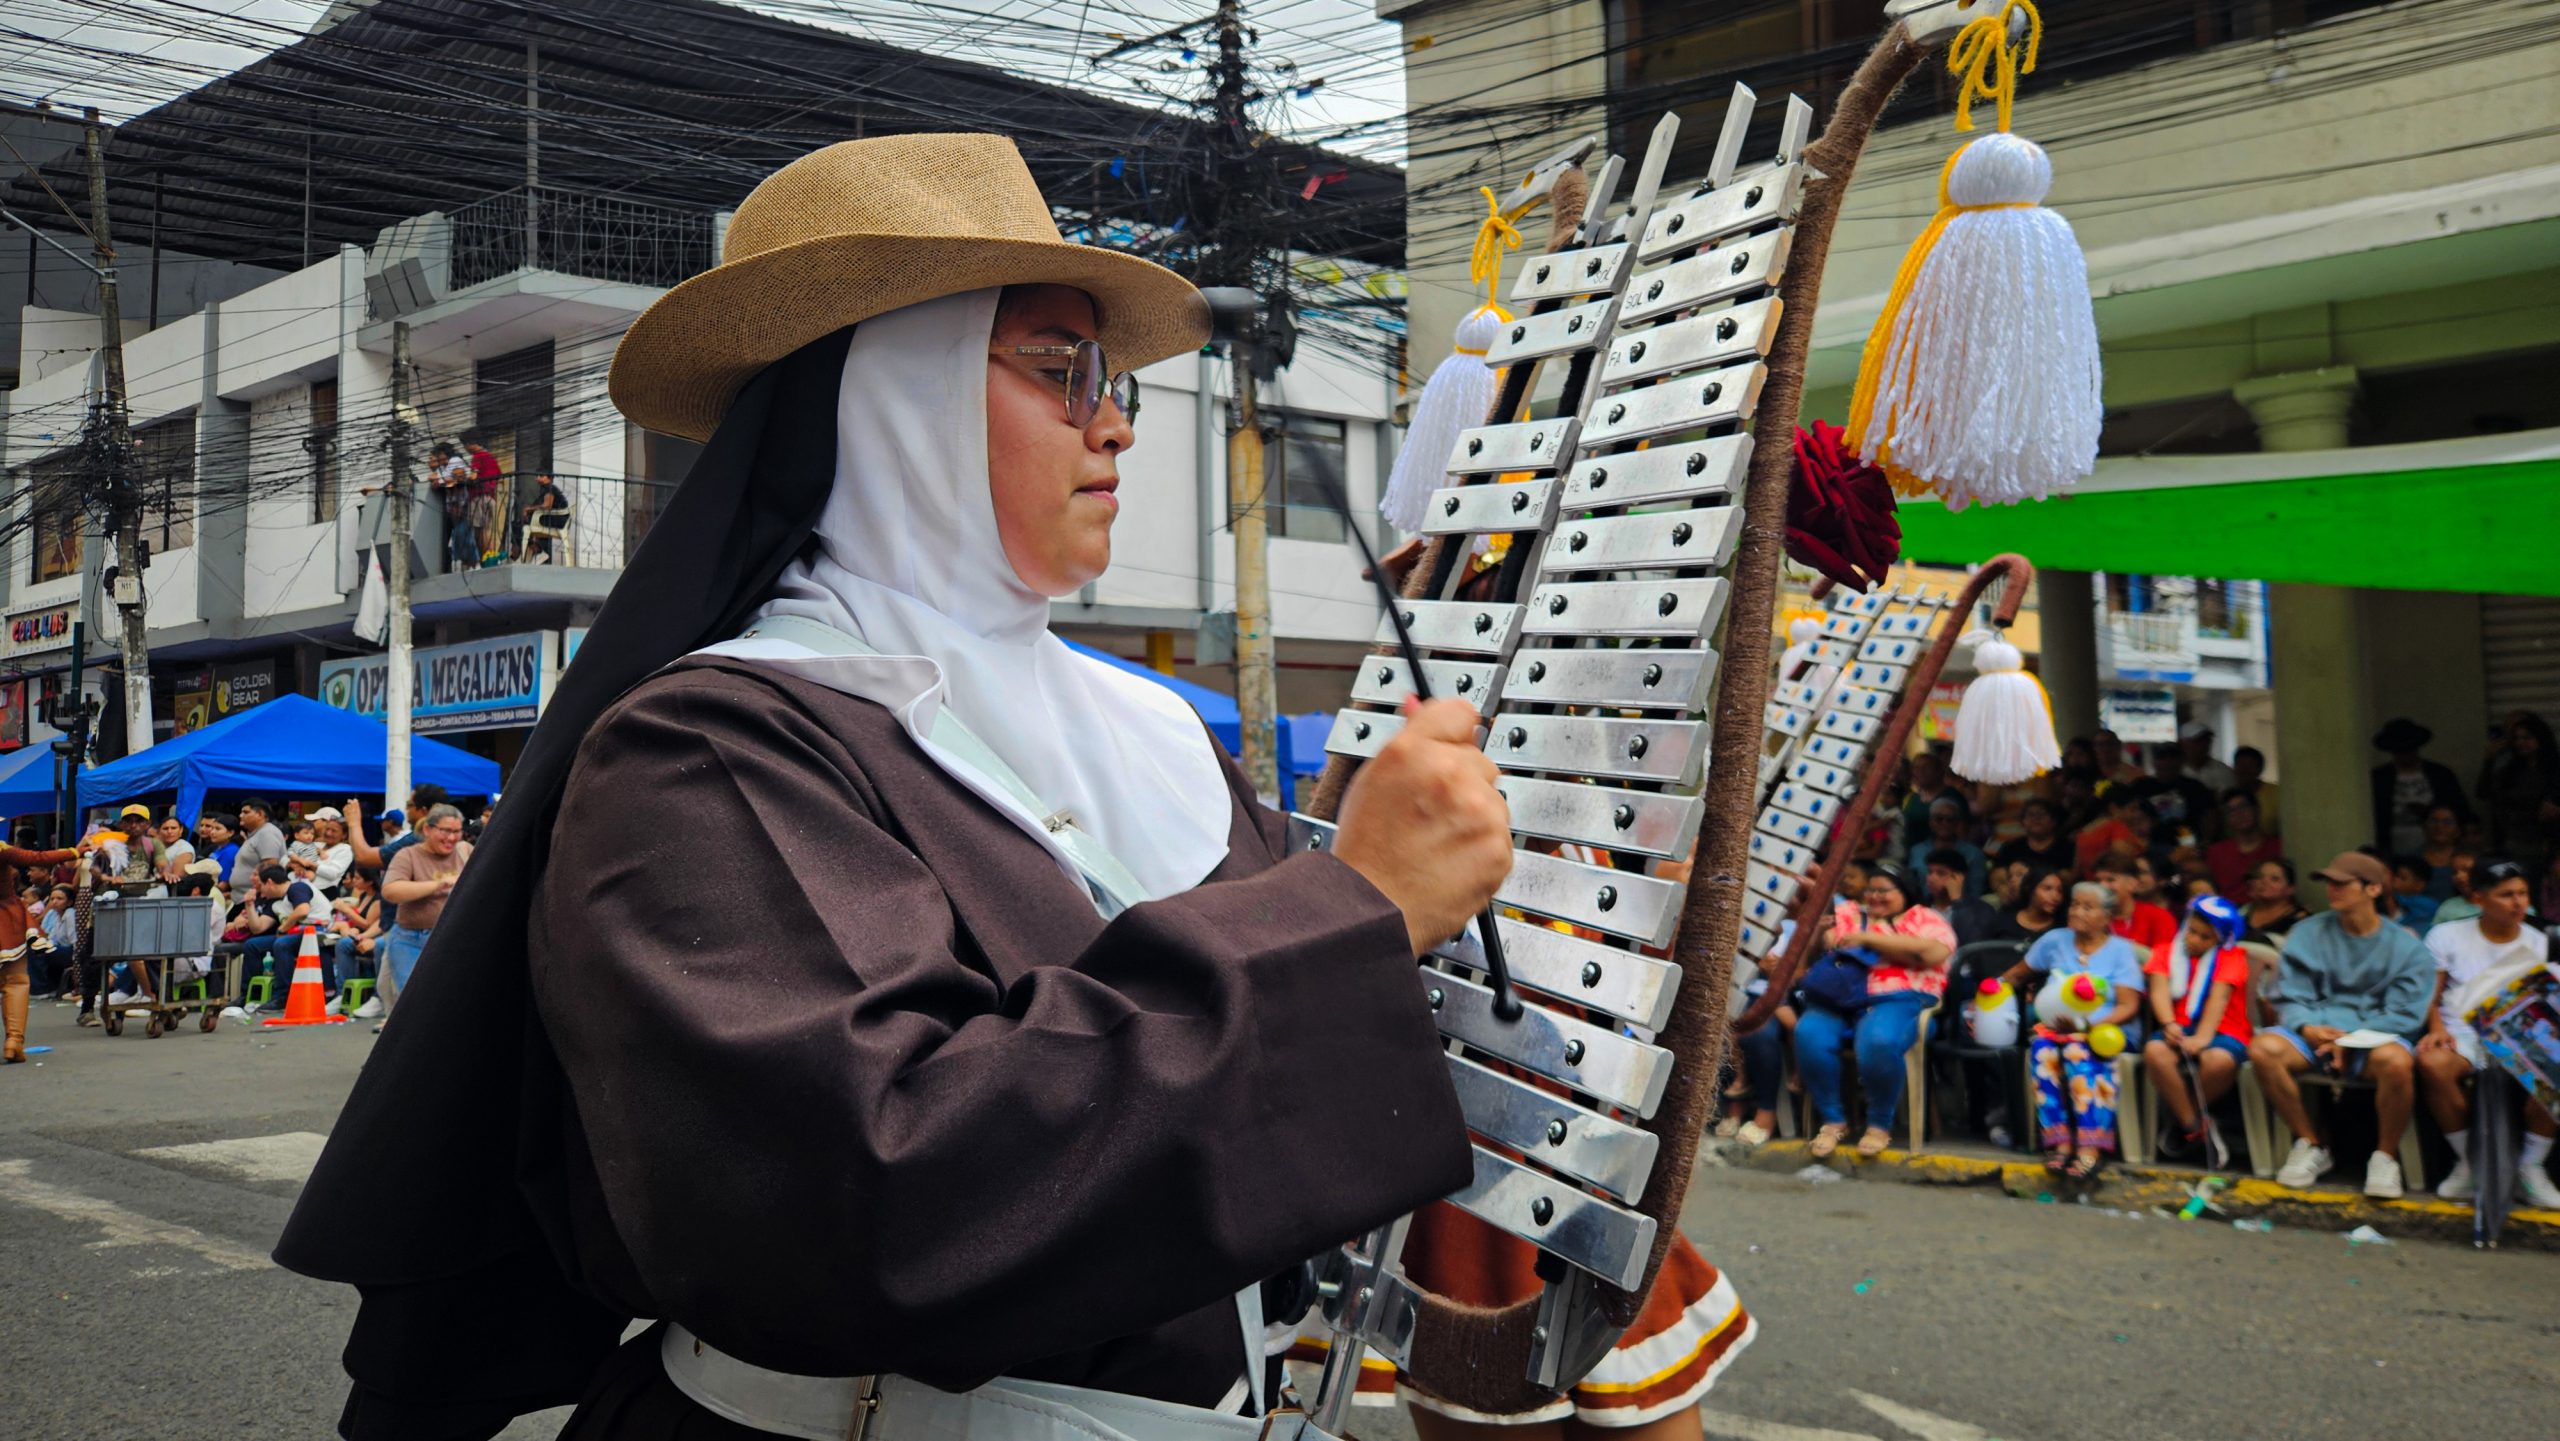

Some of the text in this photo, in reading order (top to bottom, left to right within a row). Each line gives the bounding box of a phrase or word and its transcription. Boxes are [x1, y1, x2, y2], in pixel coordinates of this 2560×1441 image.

[1625, 291, 1643, 309] SOL
[1608, 350, 1622, 367] FA
[232, 673, 271, 690] GOLDEN
[430, 645, 535, 706] MEGALENS
[232, 691, 260, 706] BEAR
